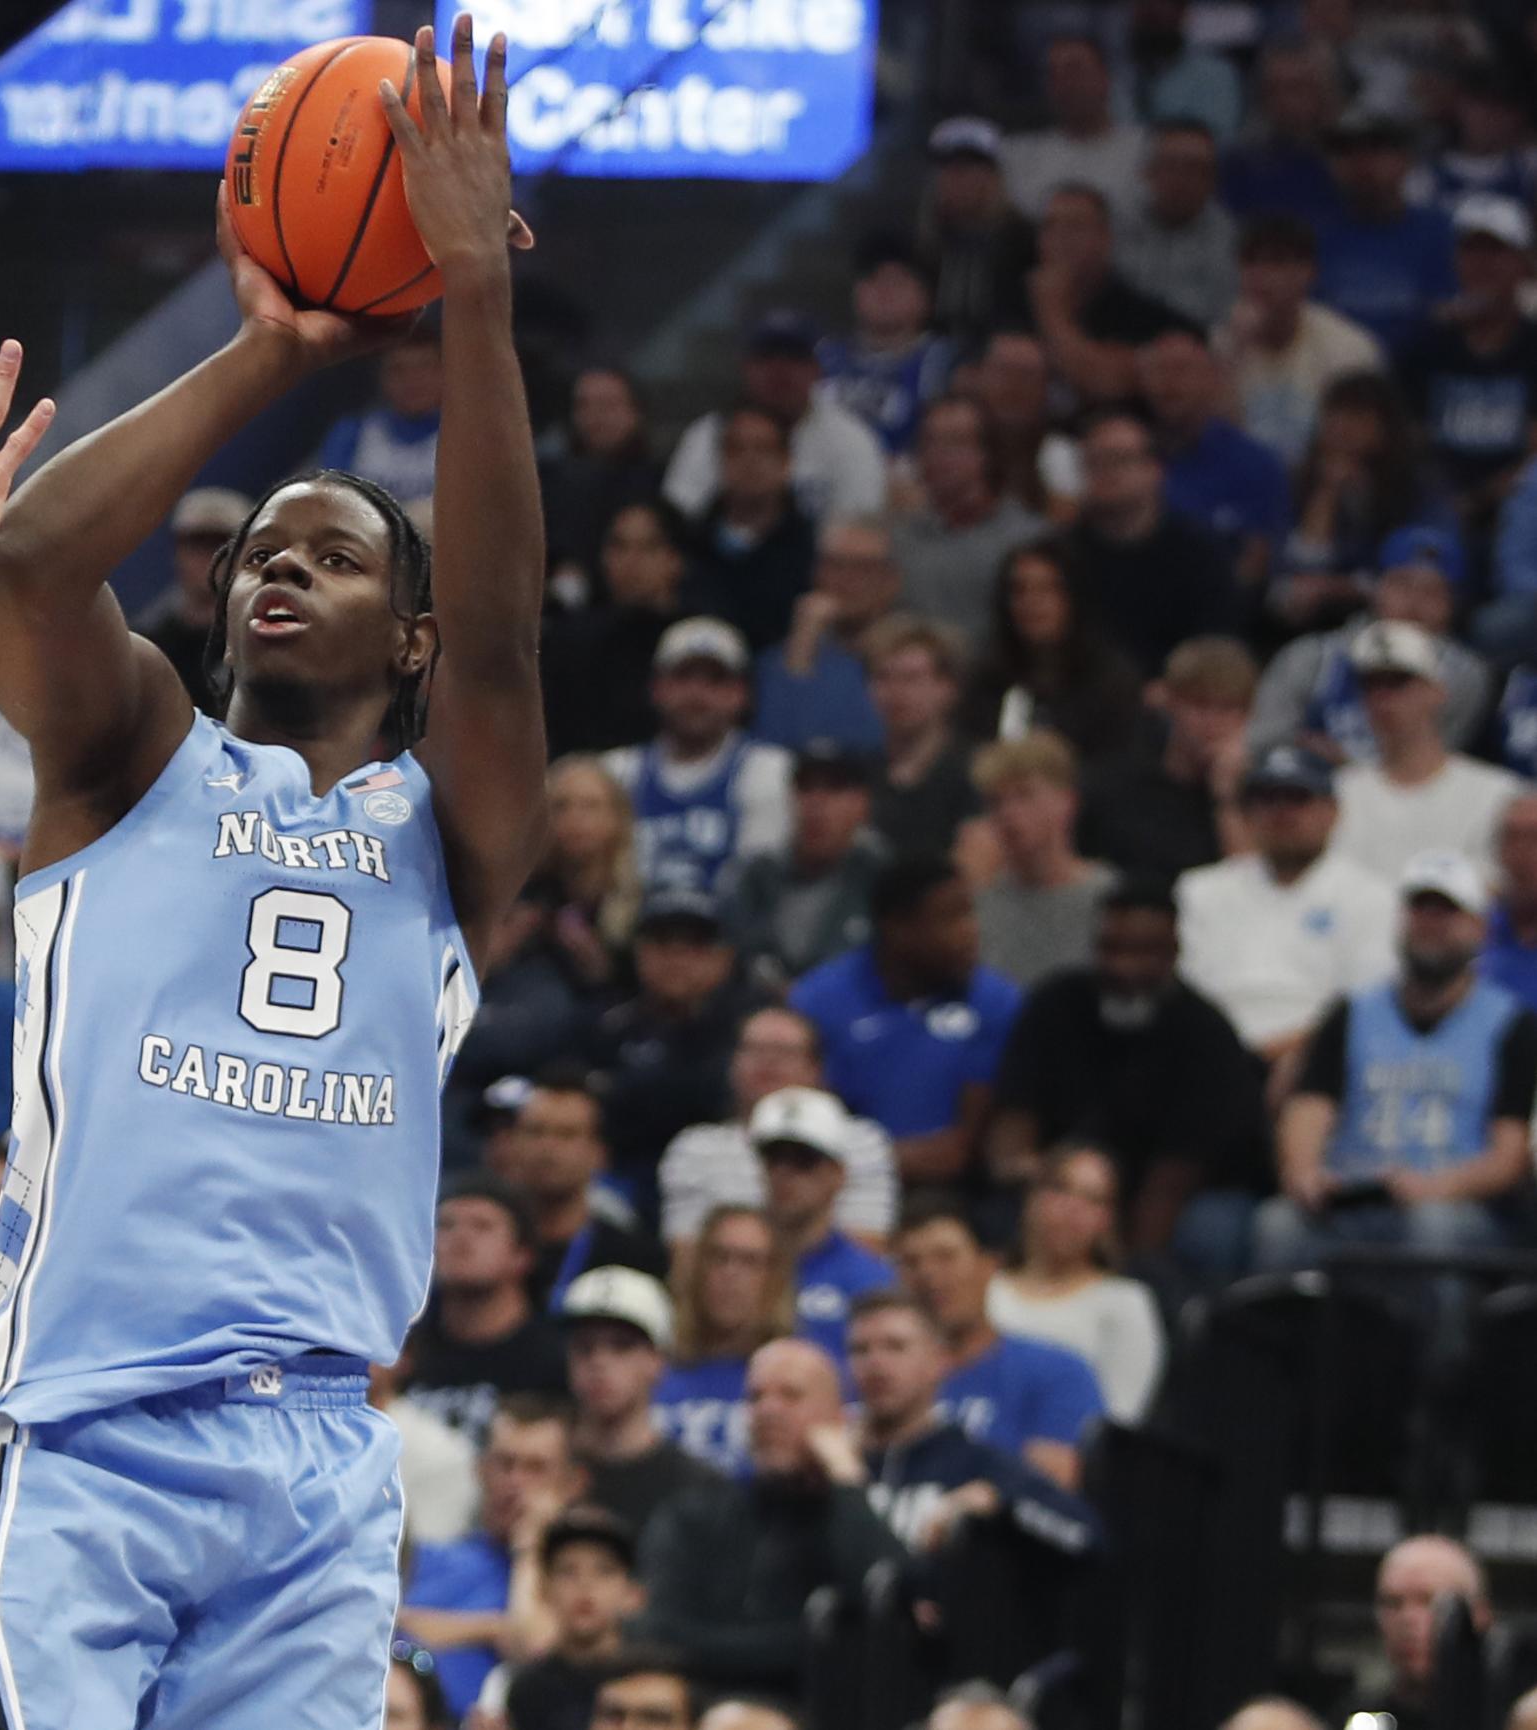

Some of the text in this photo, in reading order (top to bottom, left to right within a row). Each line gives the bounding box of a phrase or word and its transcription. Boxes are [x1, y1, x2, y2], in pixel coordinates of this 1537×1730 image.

[213, 811, 390, 882] NORTH
[237, 886, 352, 1039] 8
[138, 1034, 394, 1125] CAROLINA
